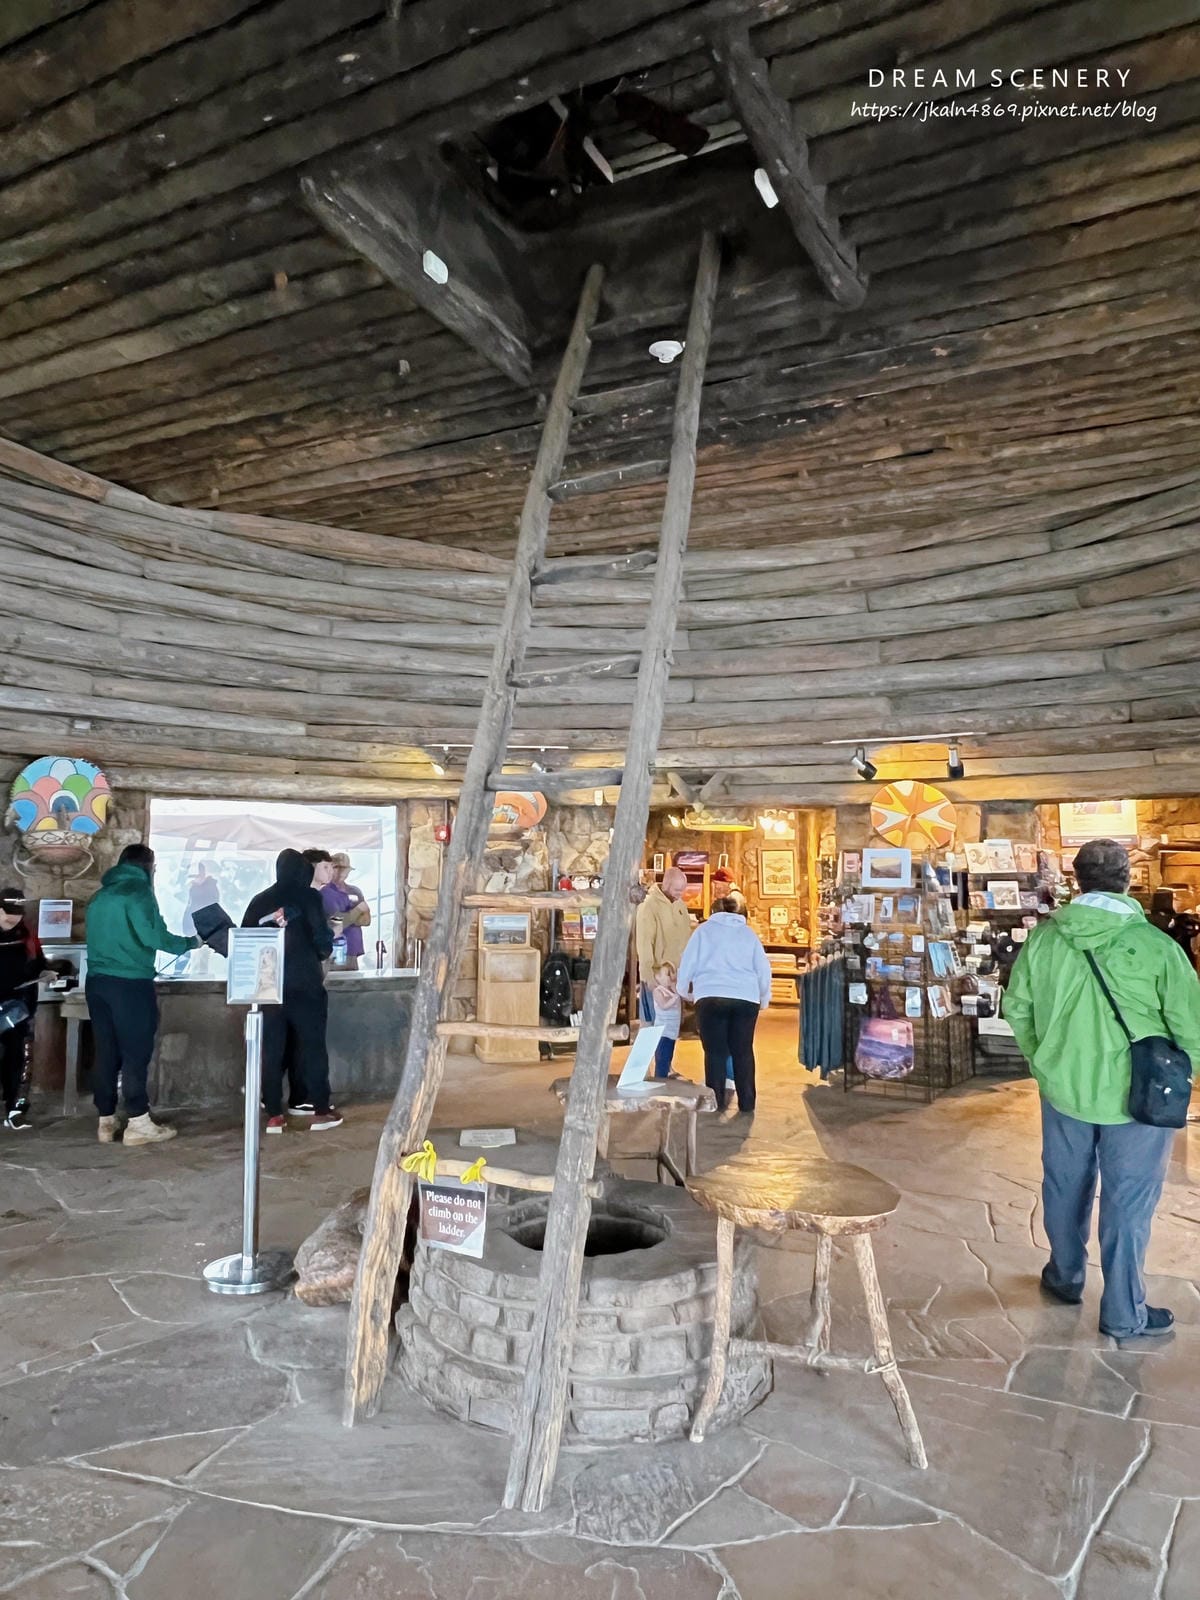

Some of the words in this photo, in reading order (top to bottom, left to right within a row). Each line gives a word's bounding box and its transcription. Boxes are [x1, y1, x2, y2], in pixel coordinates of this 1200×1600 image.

[426, 1190, 452, 1204] Please
[453, 1195, 465, 1206] do
[466, 1199, 481, 1210] not
[428, 1206, 451, 1219] climb
[452, 1212, 463, 1222] on
[465, 1212, 478, 1225] the
[439, 1222, 465, 1237] ladder.
